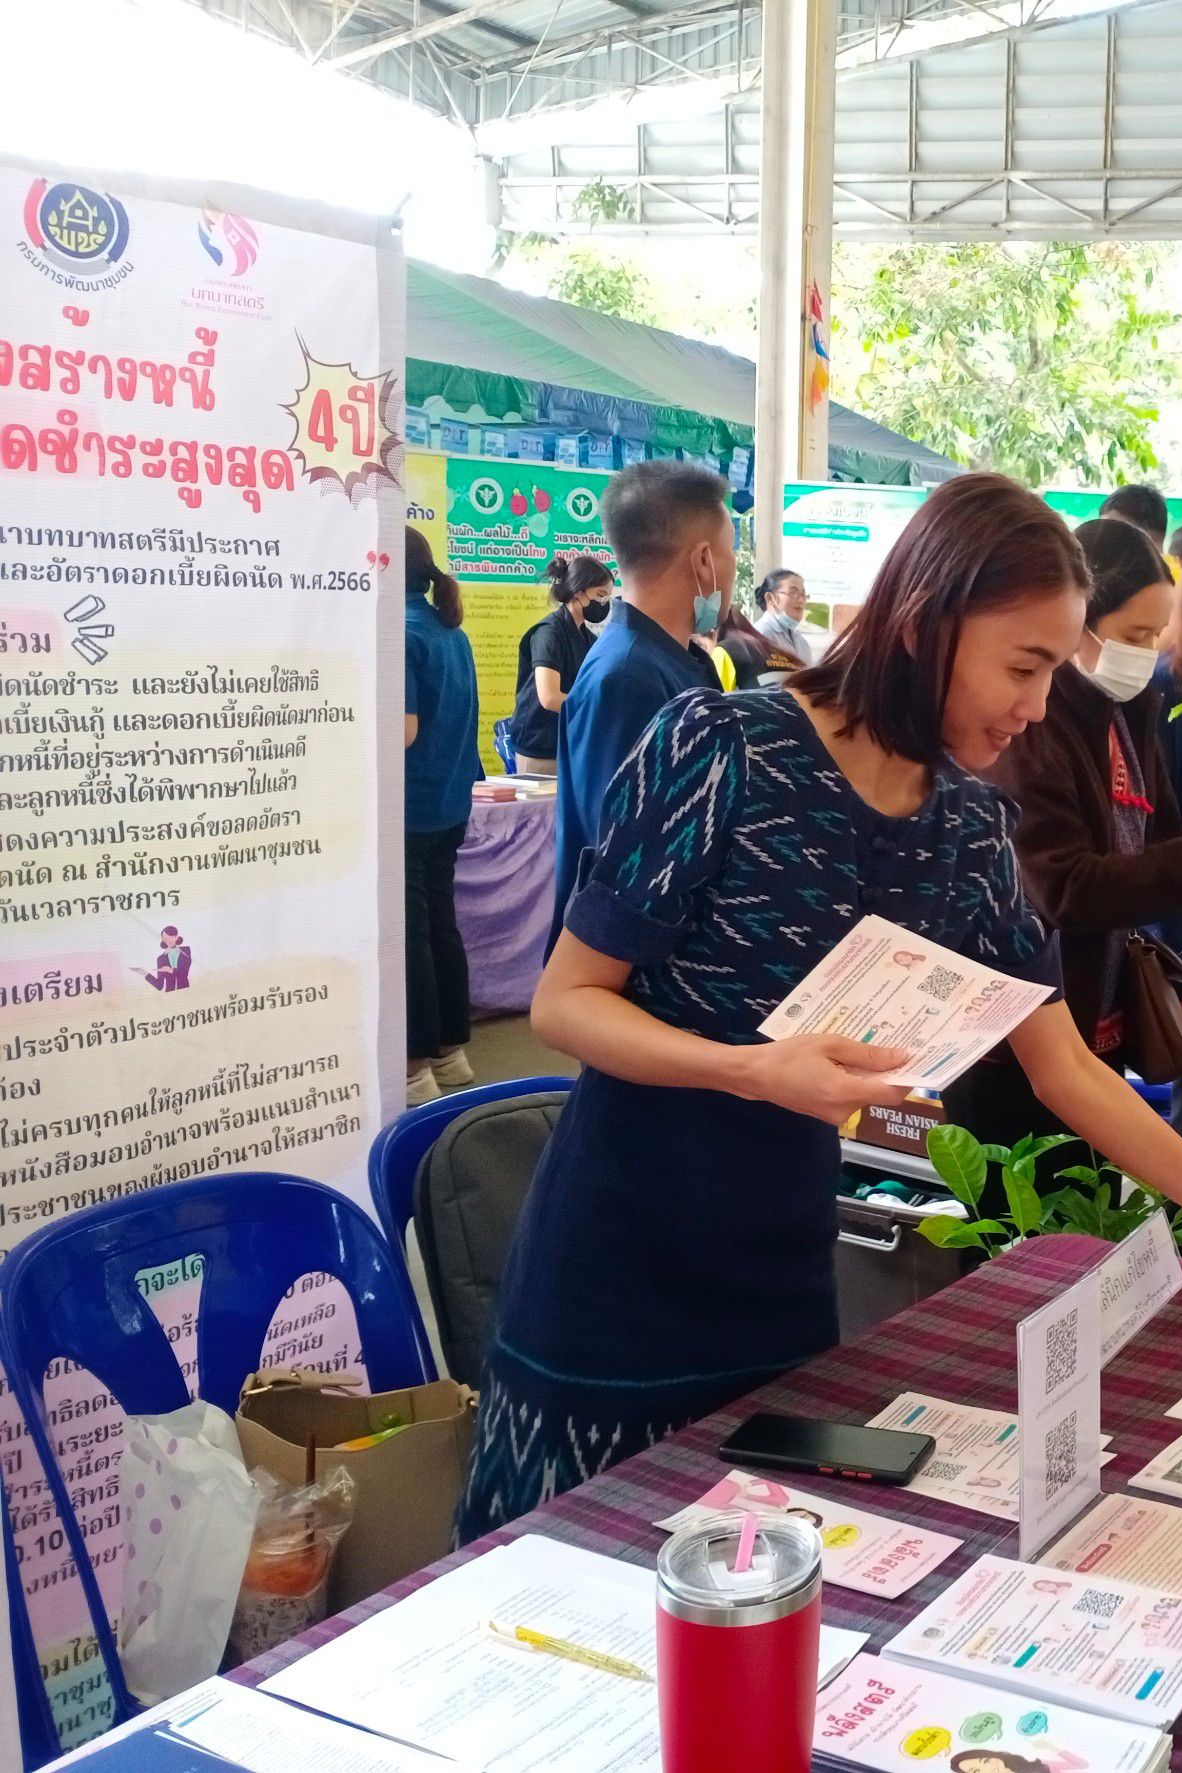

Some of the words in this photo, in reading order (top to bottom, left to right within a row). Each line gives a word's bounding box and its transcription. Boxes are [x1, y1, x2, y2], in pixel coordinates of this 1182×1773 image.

[16, 240, 135, 292] กรมการพัฒนาชุมชน
[290, 569, 371, 592] พ.ศ.2566
[0, 671, 119, 697] ดนัดชำระ
[0, 702, 105, 740] เบี้ยเงินกู้
[0, 807, 301, 852] ดงความประสงค์ขอลดอัตรา
[62, 863, 87, 882] ณ
[95, 836, 321, 880] สำนักงานพัฒนาชุมชน
[0, 982, 329, 1062] ประจำตัวประชาชนพร้อมรับรอง
[869, 1105, 902, 1123] PEARS
[905, 1113, 939, 1130] ASIAN
[886, 1122, 920, 1140] FRESH
